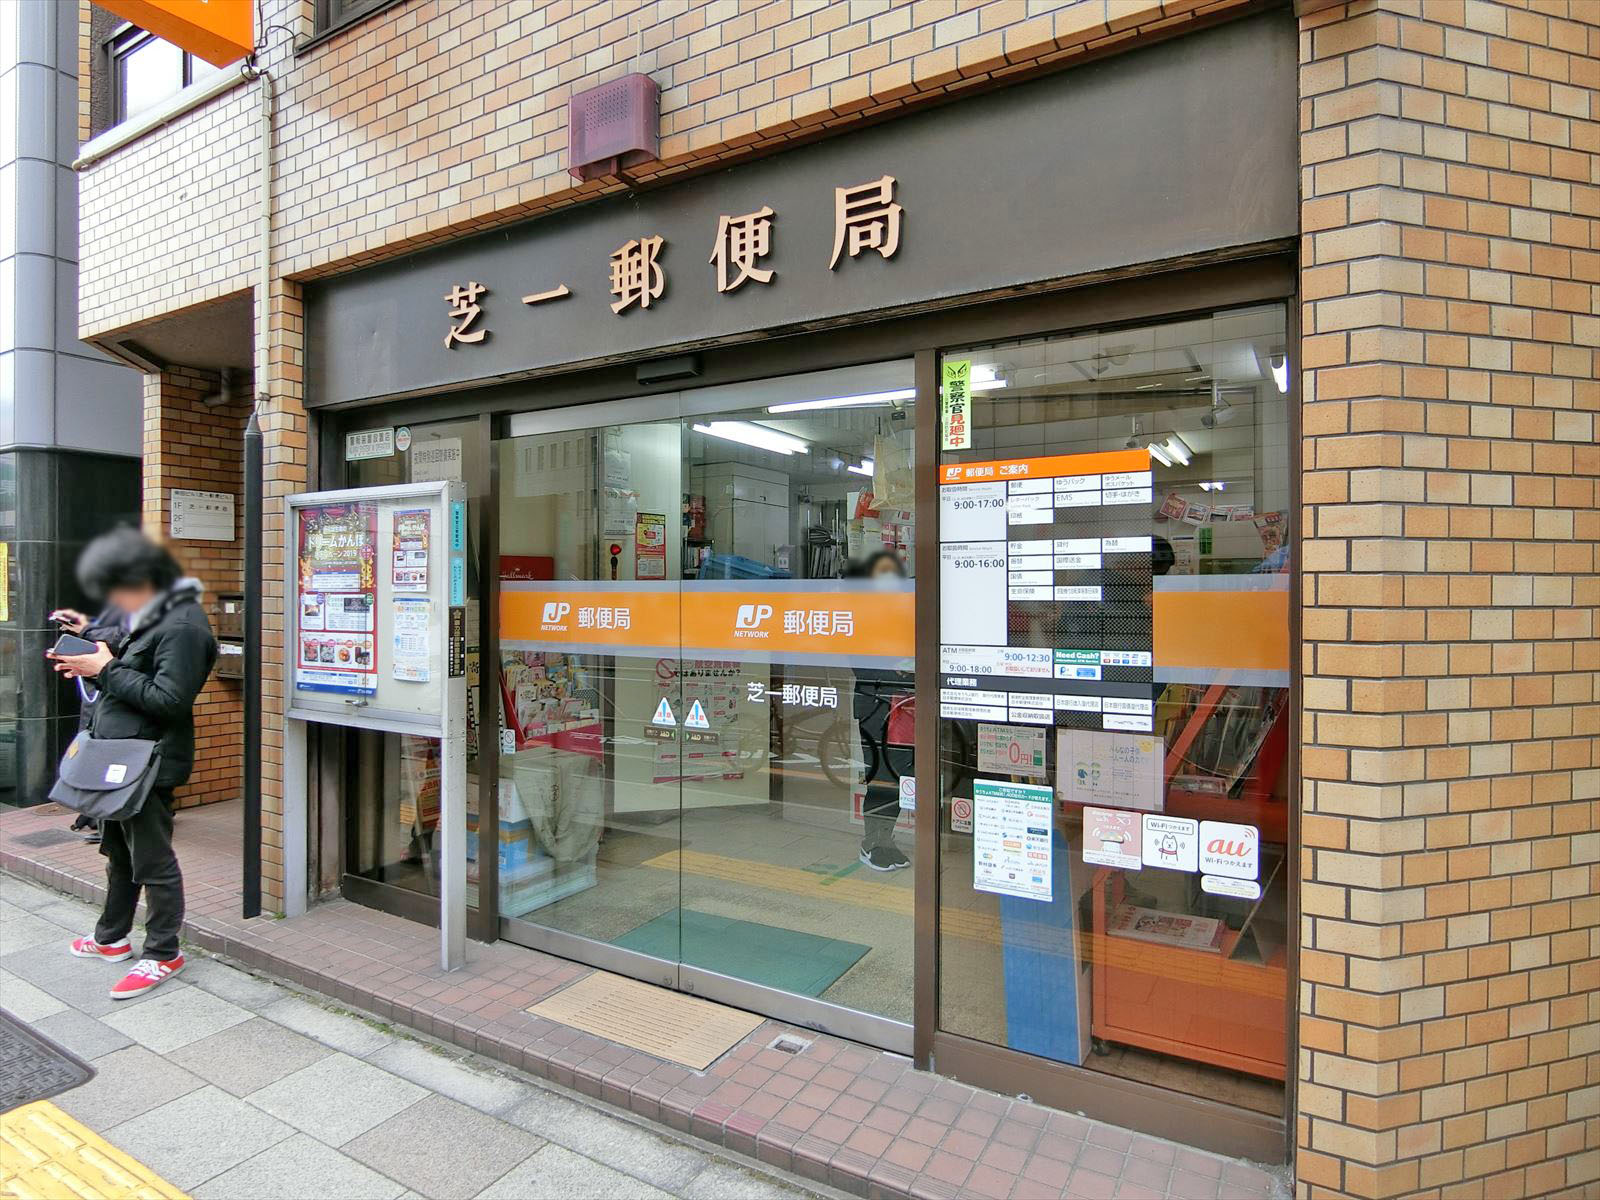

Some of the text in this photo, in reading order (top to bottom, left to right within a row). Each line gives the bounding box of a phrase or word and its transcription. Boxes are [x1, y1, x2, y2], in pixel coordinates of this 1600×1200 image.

[444, 174, 905, 349] 芝一郵便局
[949, 380, 966, 447] 警察官見廻中
[965, 464, 1029, 478] 郵便局 ご案内
[173, 501, 183, 509] 1F
[954, 498, 1005, 510] 9:00-17:00
[173, 514, 183, 522] 2F
[173, 527, 183, 535] 3F
[954, 559, 1005, 568] 9:00-16:00
[542, 602, 571, 623] JP
[577, 606, 631, 630] 郵便局
[735, 604, 773, 629] JP
[540, 624, 568, 632] NETWORK
[783, 609, 854, 637] 郵便局
[733, 630, 769, 639] NETWORK
[942, 646, 958, 654] ATM
[1055, 651, 1100, 660] Need Cash?
[1004, 652, 1050, 663] 9:00-12:30
[949, 664, 992, 674] 9:00-18:00
[747, 681, 838, 709] 芝一郵便局
[1206, 838, 1252, 857] au
